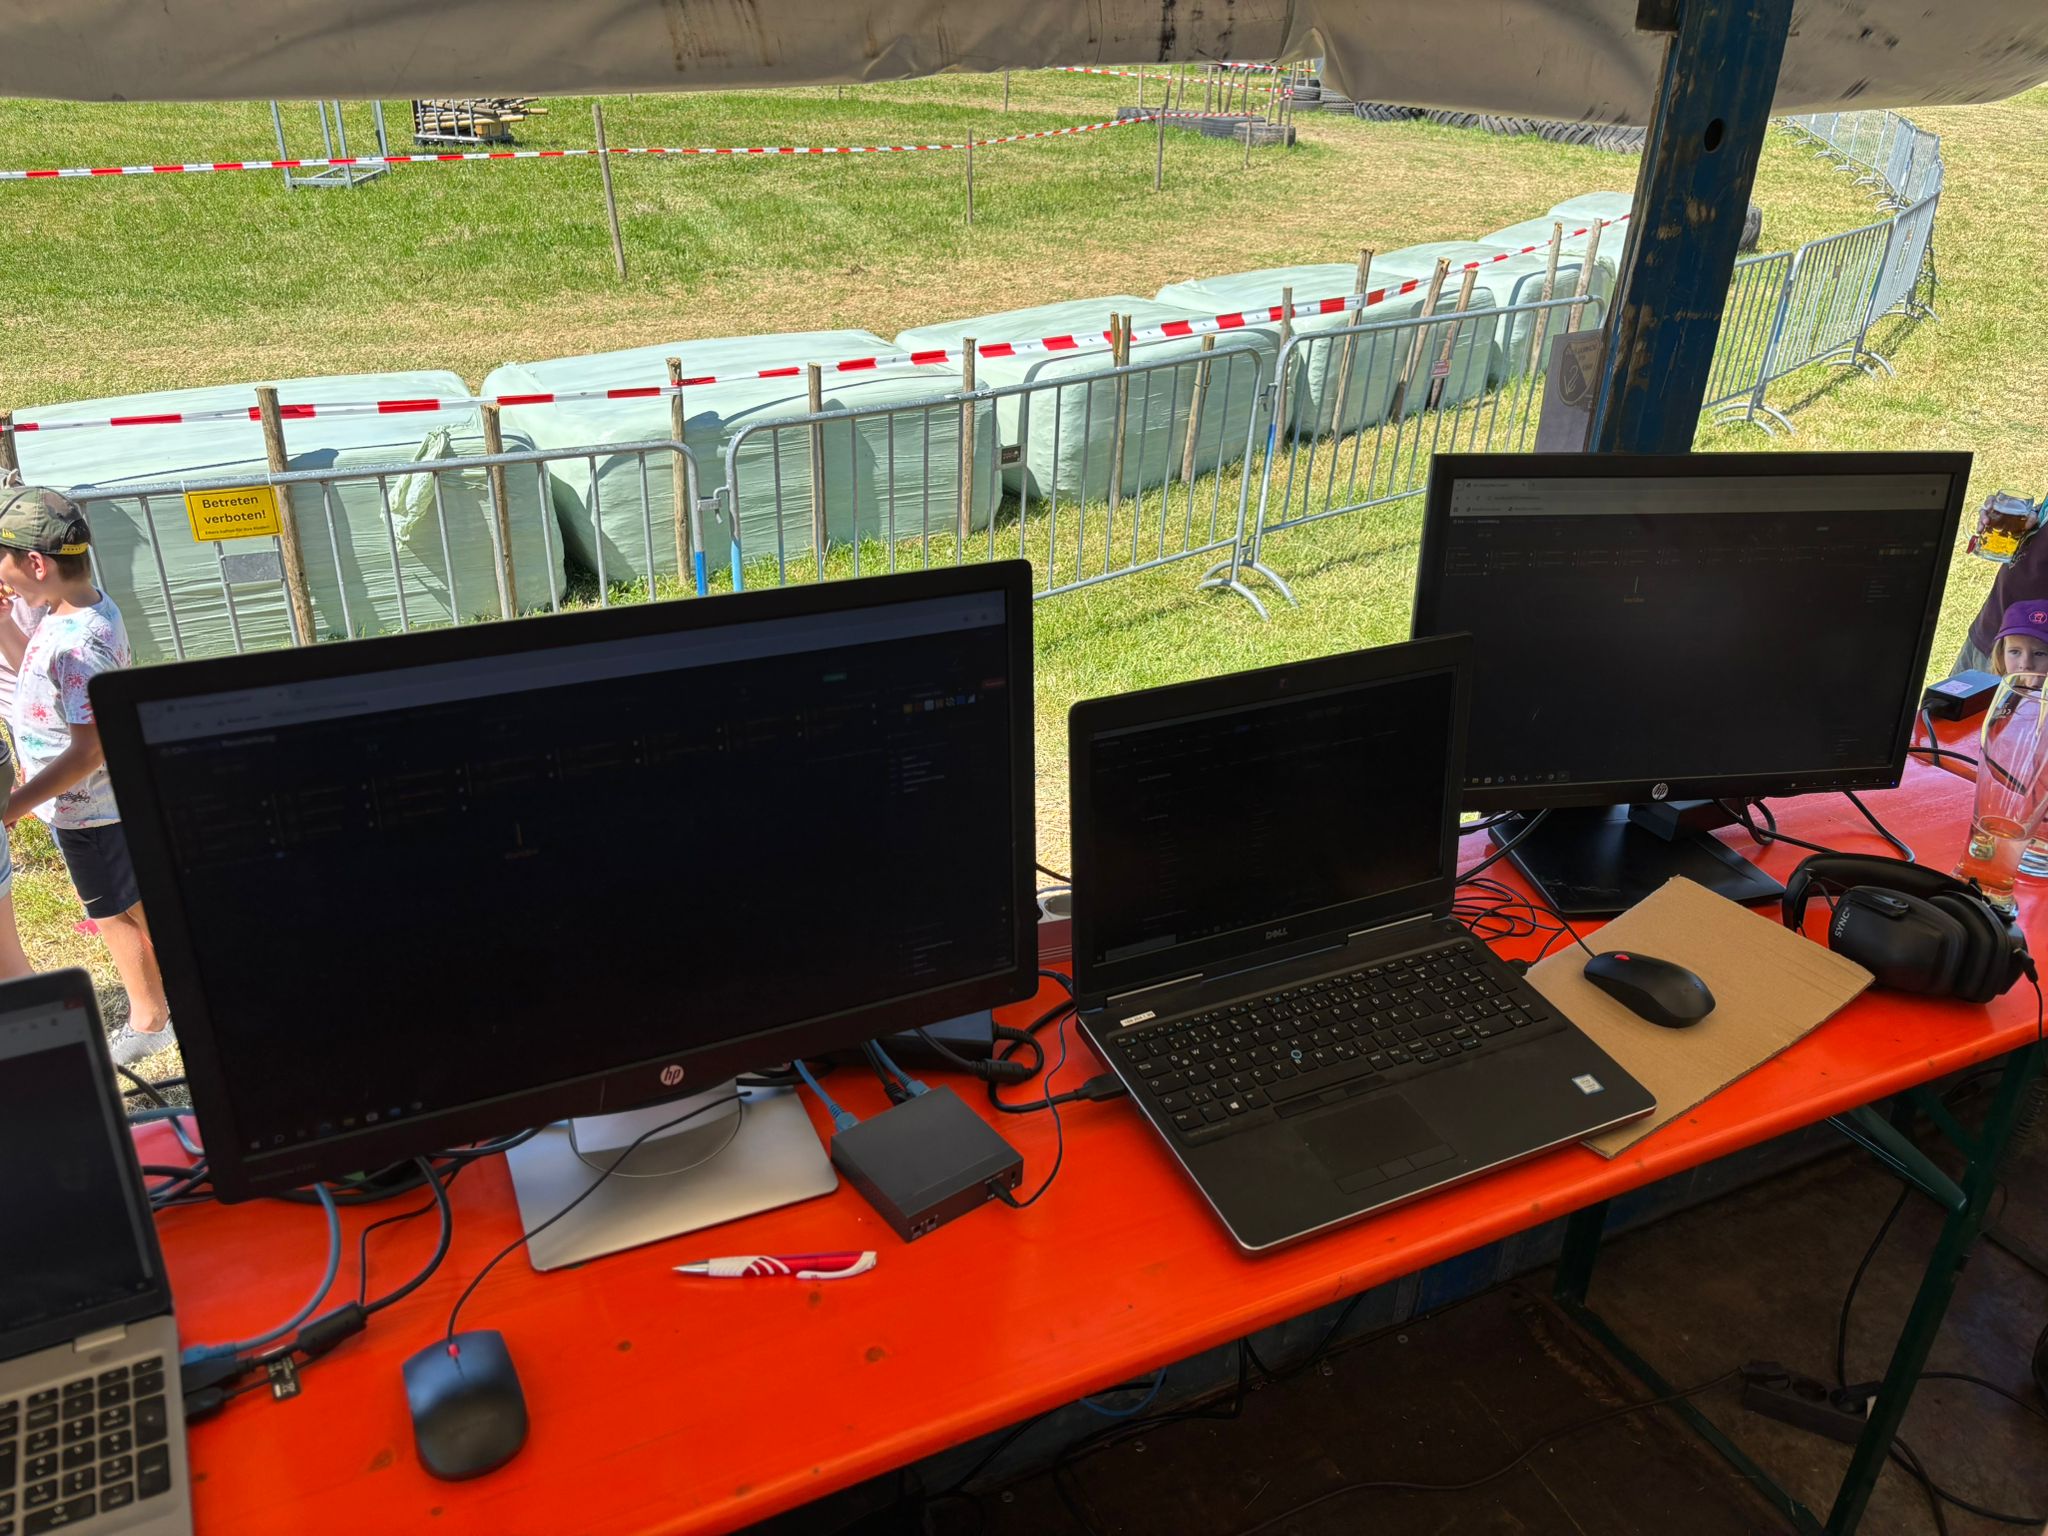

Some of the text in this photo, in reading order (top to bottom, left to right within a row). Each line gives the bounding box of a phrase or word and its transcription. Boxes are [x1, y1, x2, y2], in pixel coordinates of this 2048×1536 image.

[202, 496, 259, 509] Betreten
[204, 509, 266, 524] verboten!
[1652, 782, 1668, 800] hp
[1835, 910, 1850, 938] SYNC
[1265, 927, 1288, 940] DELL
[660, 1065, 684, 1086] hp
